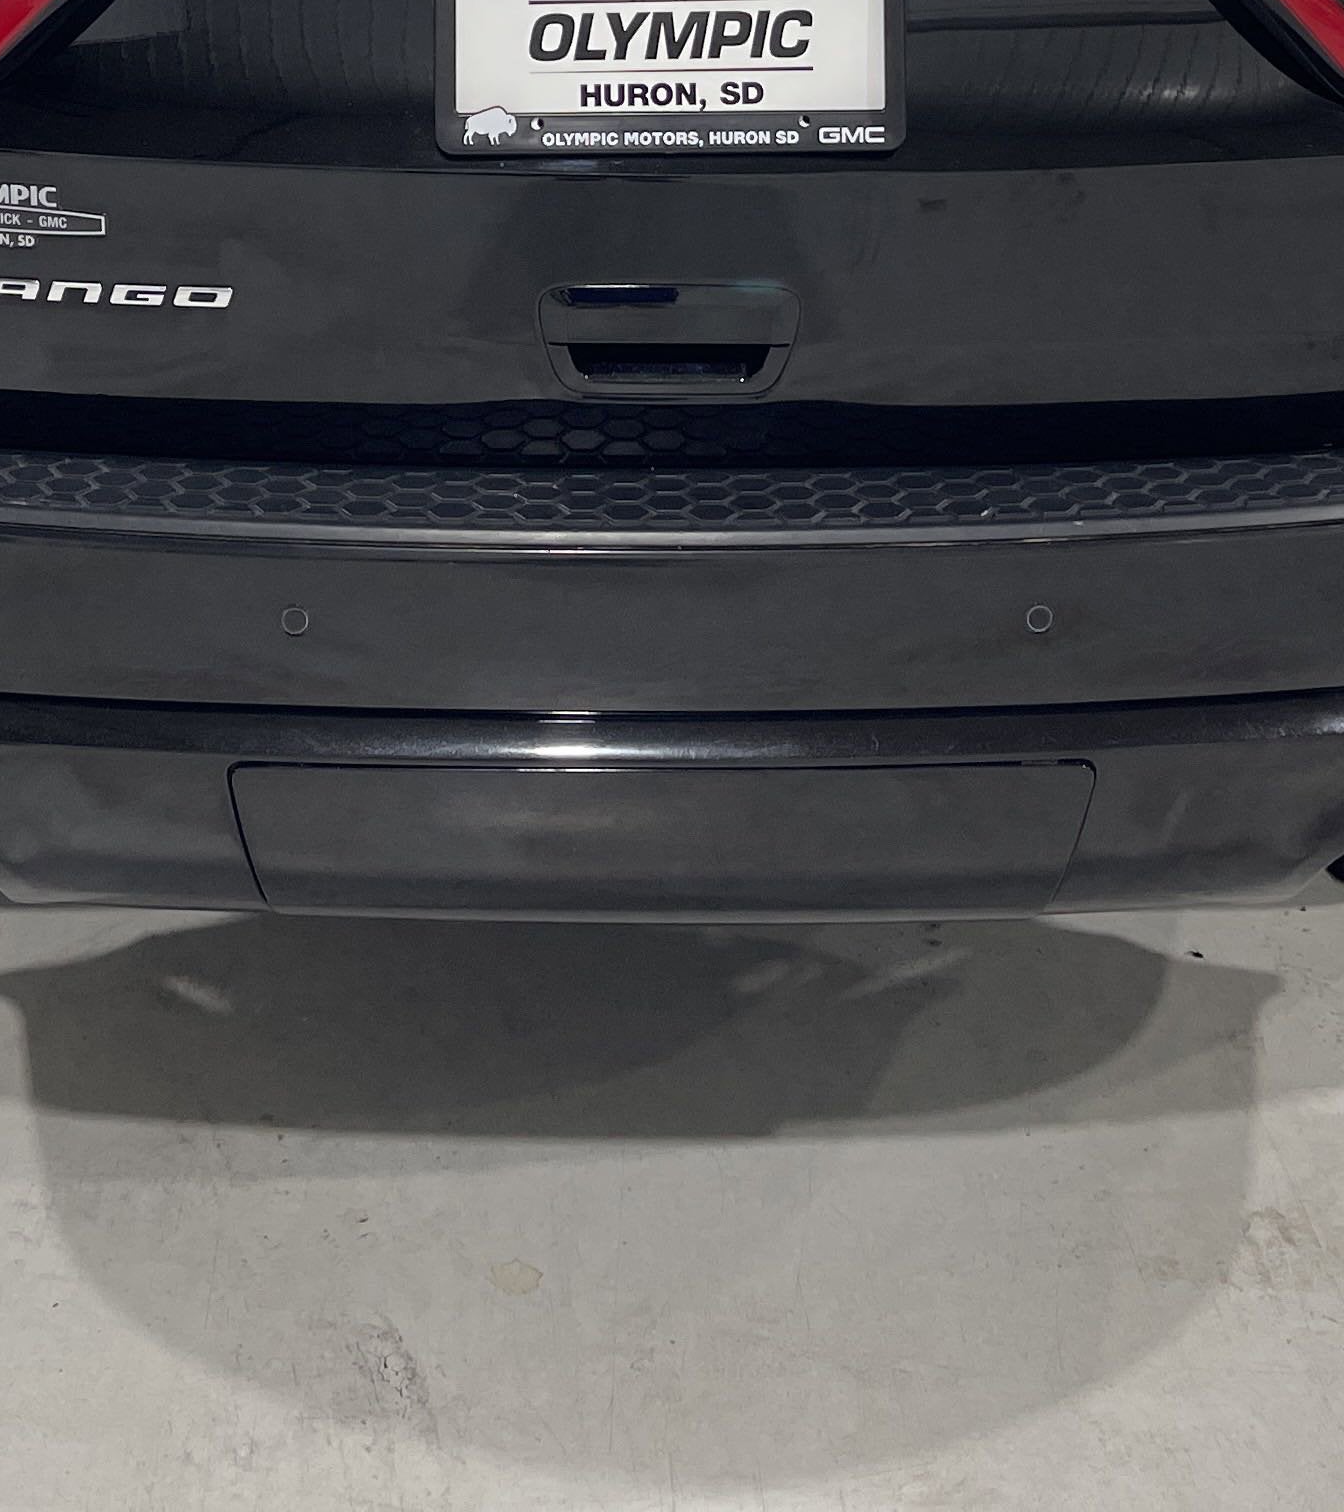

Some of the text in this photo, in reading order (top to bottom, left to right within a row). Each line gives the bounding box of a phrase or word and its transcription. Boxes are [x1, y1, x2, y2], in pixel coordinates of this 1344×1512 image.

[529, 10, 813, 61] OLYMPIC
[580, 82, 764, 111] HURON, SD
[542, 130, 800, 148] OLYMPIC MOTORS, HURON SD
[818, 126, 886, 144] GMC
[38, 215, 68, 229] GMC
[17, 235, 35, 248] SD
